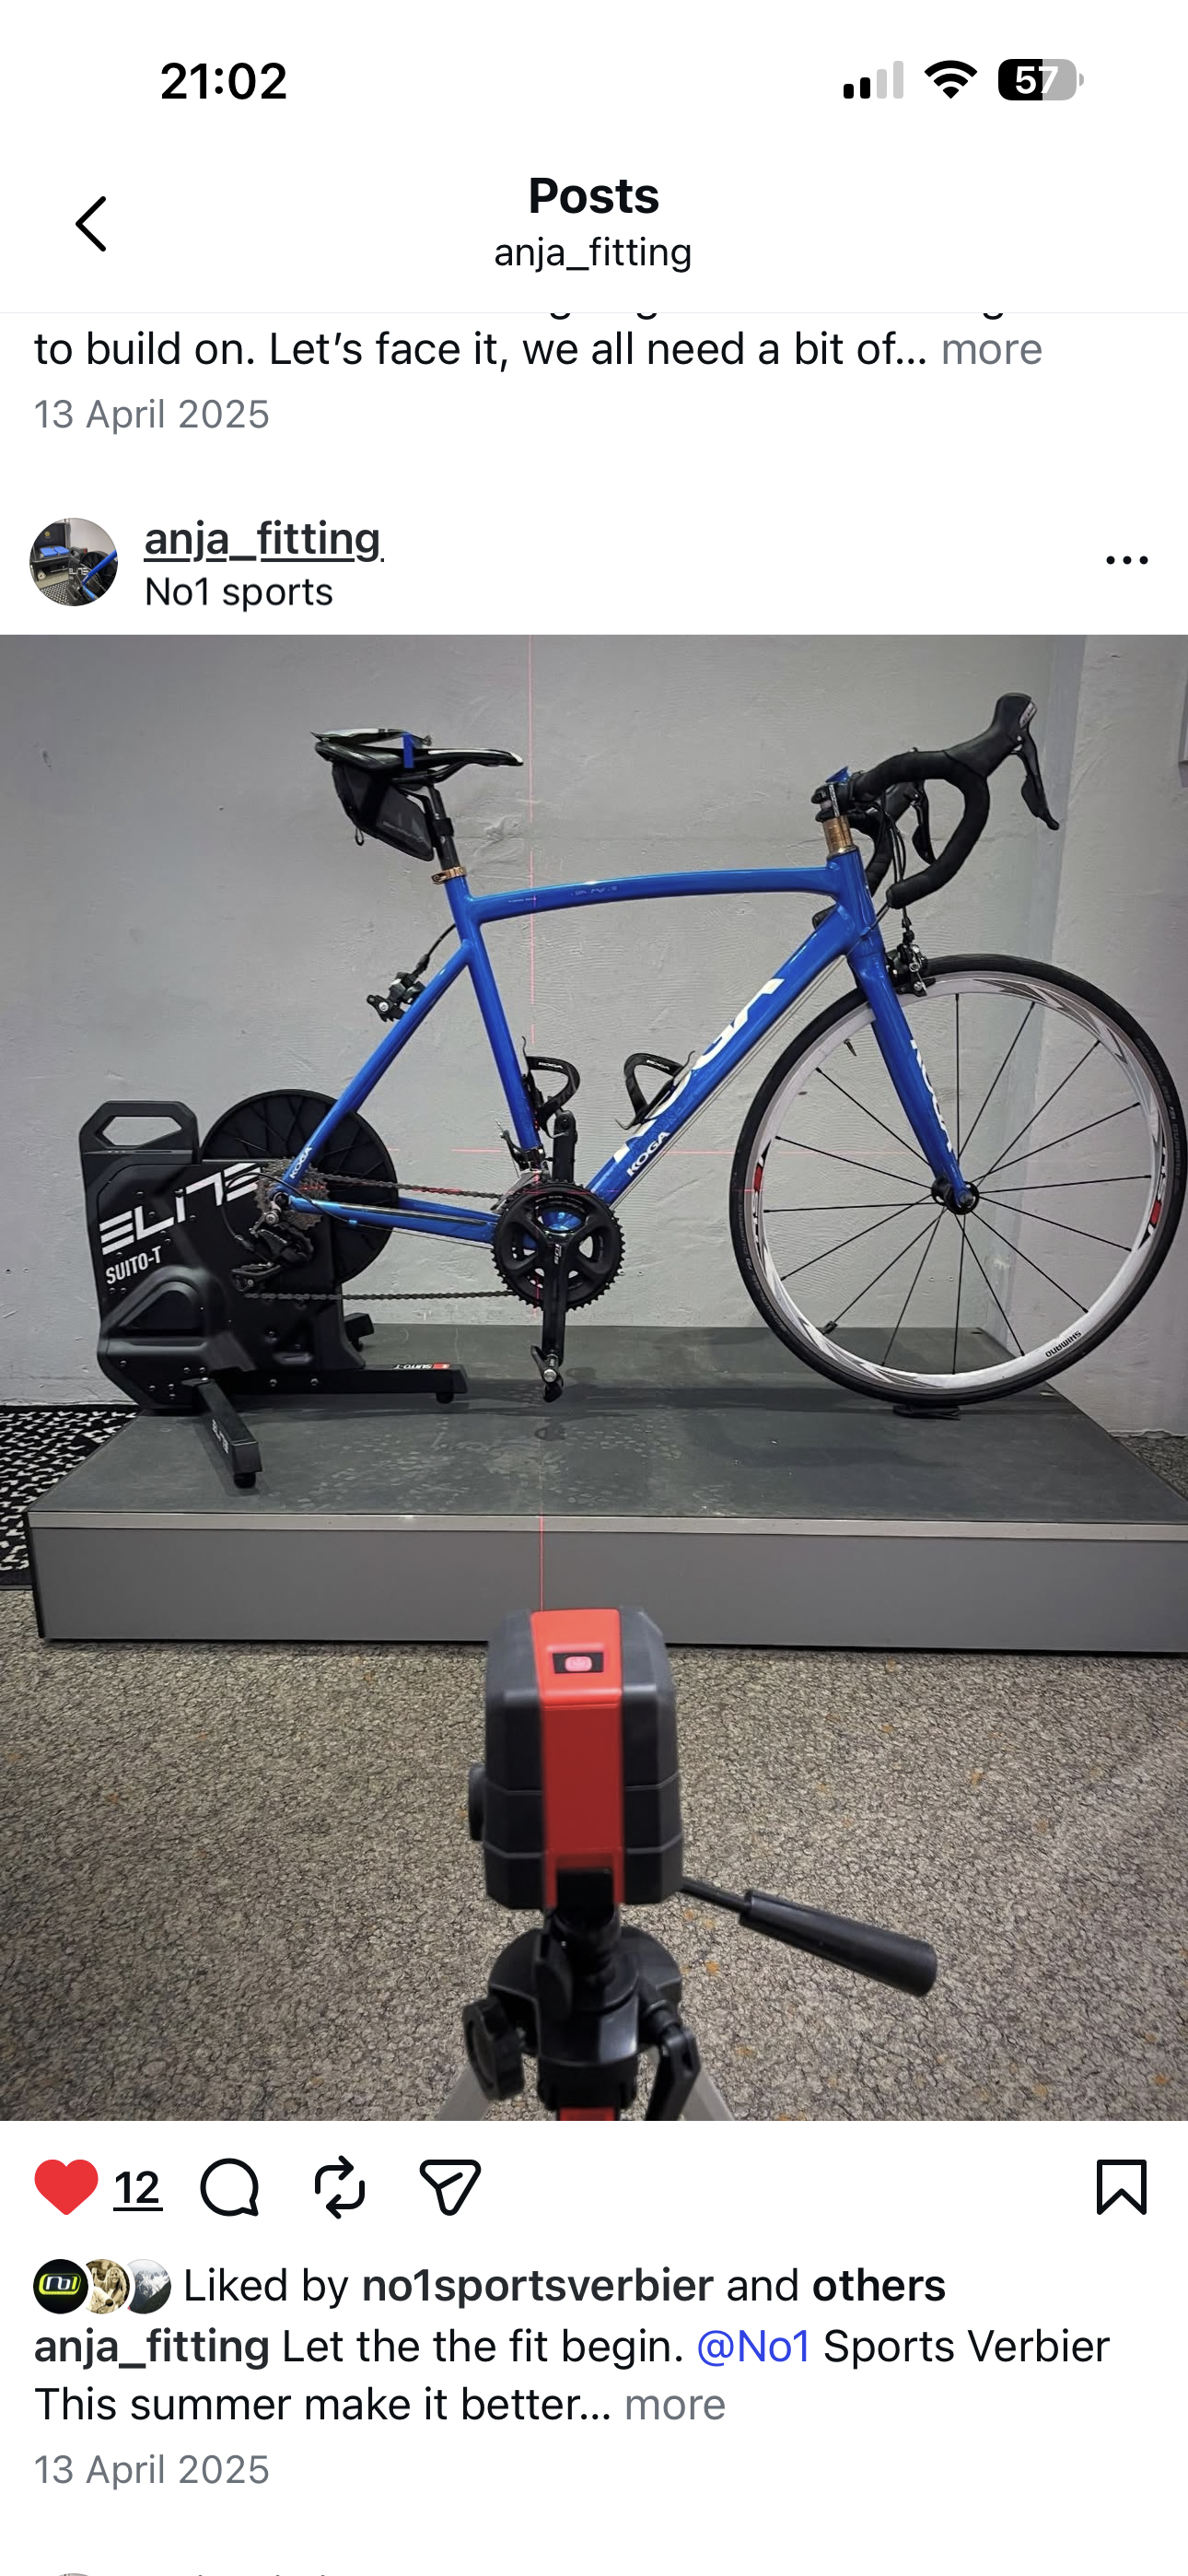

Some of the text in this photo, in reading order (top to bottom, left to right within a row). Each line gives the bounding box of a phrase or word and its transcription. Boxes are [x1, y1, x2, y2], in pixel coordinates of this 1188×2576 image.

[161, 63, 286, 100] 21:02
[1016, 66, 1059, 94] 57
[530, 178, 658, 214] Posts
[495, 237, 691, 273] anja_fitting
[34, 334, 72, 365] to
[88, 331, 180, 365] build
[195, 340, 253, 365] on.
[376, 331, 460, 365] face
[475, 331, 507, 372] it,
[523, 340, 577, 365] we
[592, 331, 632, 365] all
[649, 331, 743, 365] need
[759, 340, 778, 365] a
[797, 331, 843, 365] bit
[944, 340, 1042, 365] more
[36, 399, 268, 434] 13 April 2025
[144, 520, 380, 562] anja_fitting
[147, 577, 332, 612] No1 sports
[289, 1146, 312, 1179] KOGA
[626, 1131, 671, 1177] KOGA
[99, 1162, 262, 1256] ELITE
[106, 1246, 163, 1285] SUITO-T
[1045, 1331, 1082, 1358] SHIMANO
[113, 2171, 163, 2205] 12
[186, 2266, 945, 2309] Liked by no1sportsverbier and others
[35, 2327, 1110, 2370] anja_fitting Let the the fit begin. @No1 Sports Verbier
[35, 2386, 116, 2420] This
[131, 2395, 291, 2420] summer
[307, 2386, 410, 2420] make
[425, 2386, 447, 2419] it
[627, 2395, 725, 2420] more
[36, 2454, 268, 2489] 13 April 2025
